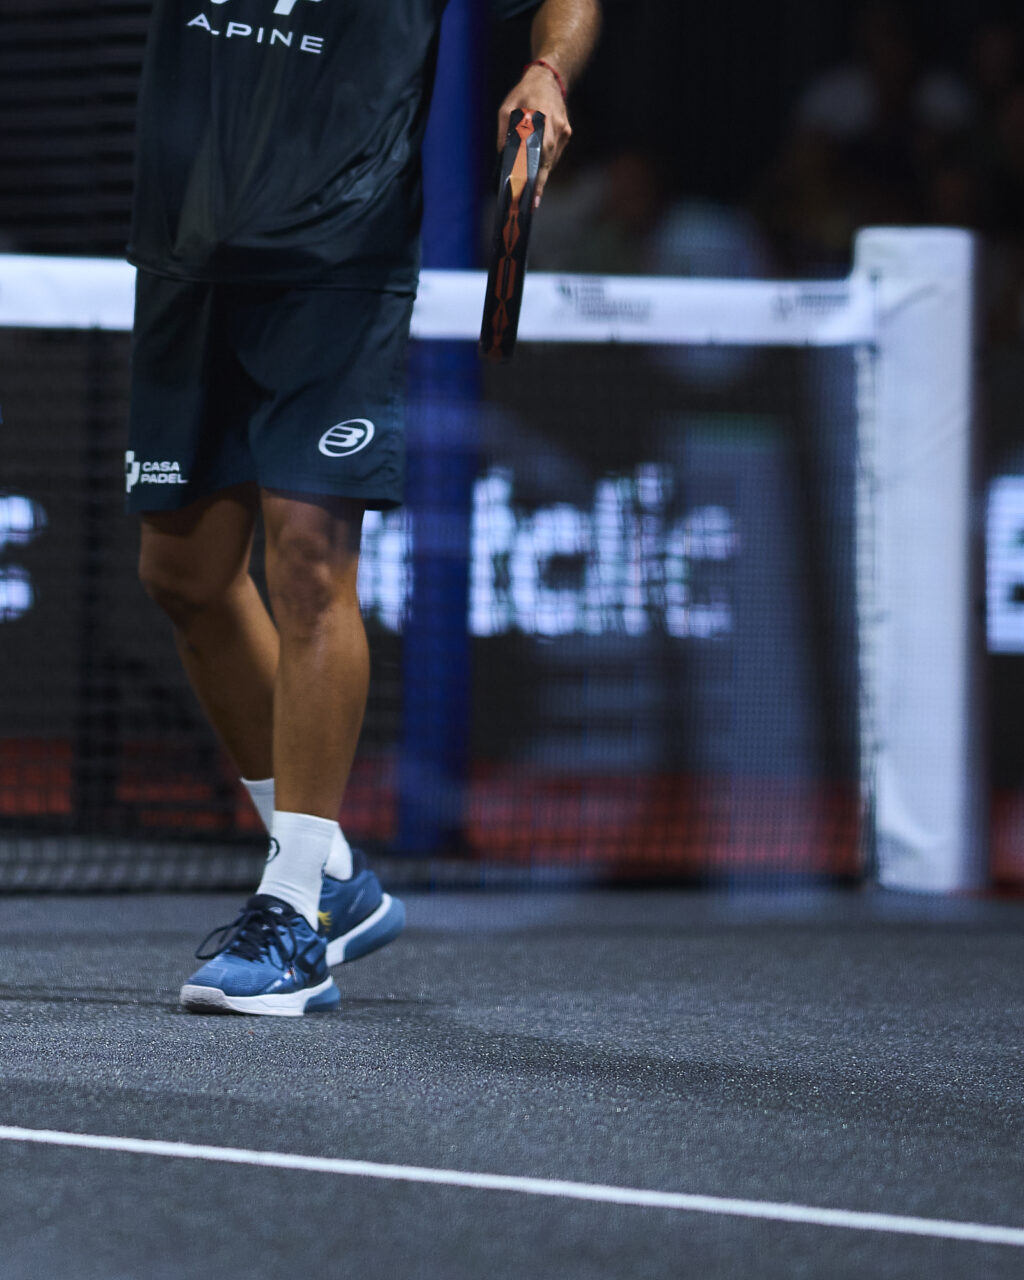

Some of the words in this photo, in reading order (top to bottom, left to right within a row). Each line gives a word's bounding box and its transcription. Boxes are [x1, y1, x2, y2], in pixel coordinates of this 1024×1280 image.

[186, 12, 324, 54] ALPINE
[142, 461, 180, 472] CASA
[140, 473, 188, 484] PADEL
